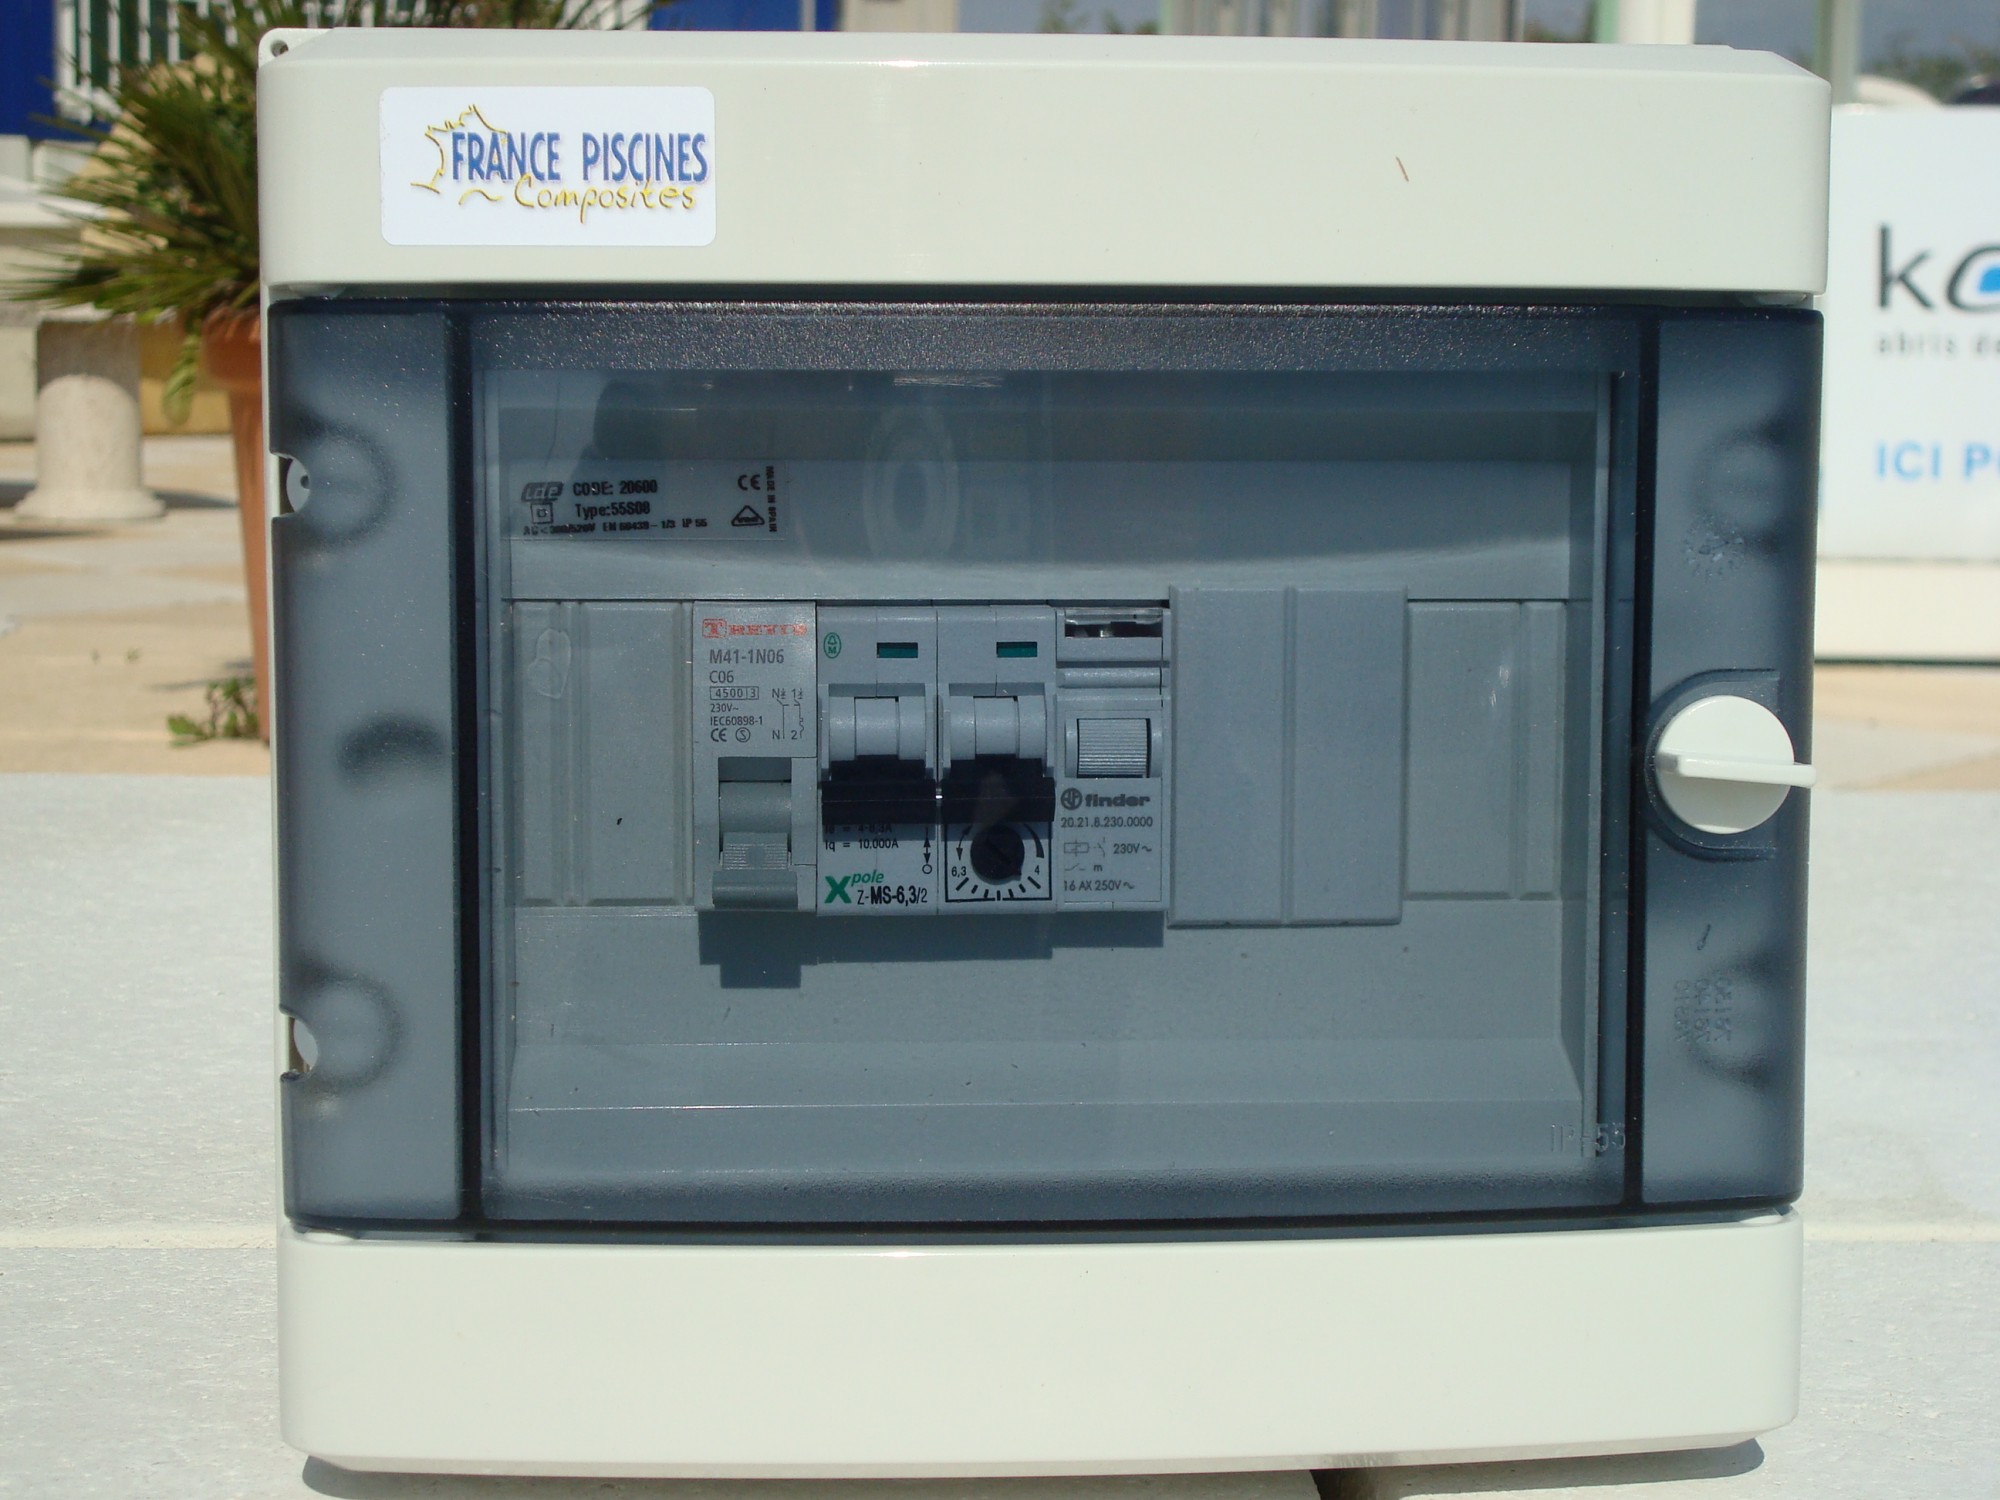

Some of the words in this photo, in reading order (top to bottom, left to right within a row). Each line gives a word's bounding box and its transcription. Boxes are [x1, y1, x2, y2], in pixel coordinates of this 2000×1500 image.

[451, 132, 560, 182] FRANCE
[582, 132, 708, 182] PISCINES
[514, 173, 696, 224] Composites
[1876, 440, 1941, 480] ICI
[573, 481, 614, 497] CODE:
[619, 479, 658, 495] 20600
[709, 648, 785, 664] M41-1N06
[709, 670, 734, 684] C06
[715, 687, 744, 698] 4500
[750, 687, 757, 698] 3
[710, 716, 763, 726] IEC60898-1
[1085, 793, 1151, 808] finder
[951, 866, 967, 877] 6,3
[1034, 865, 1041, 875] 4
[824, 876, 851, 904] X
[851, 869, 884, 887] pole
[1063, 880, 1076, 892] 16
[1078, 880, 1092, 892] AX
[857, 886, 928, 906] Z-MS-6,3/2
